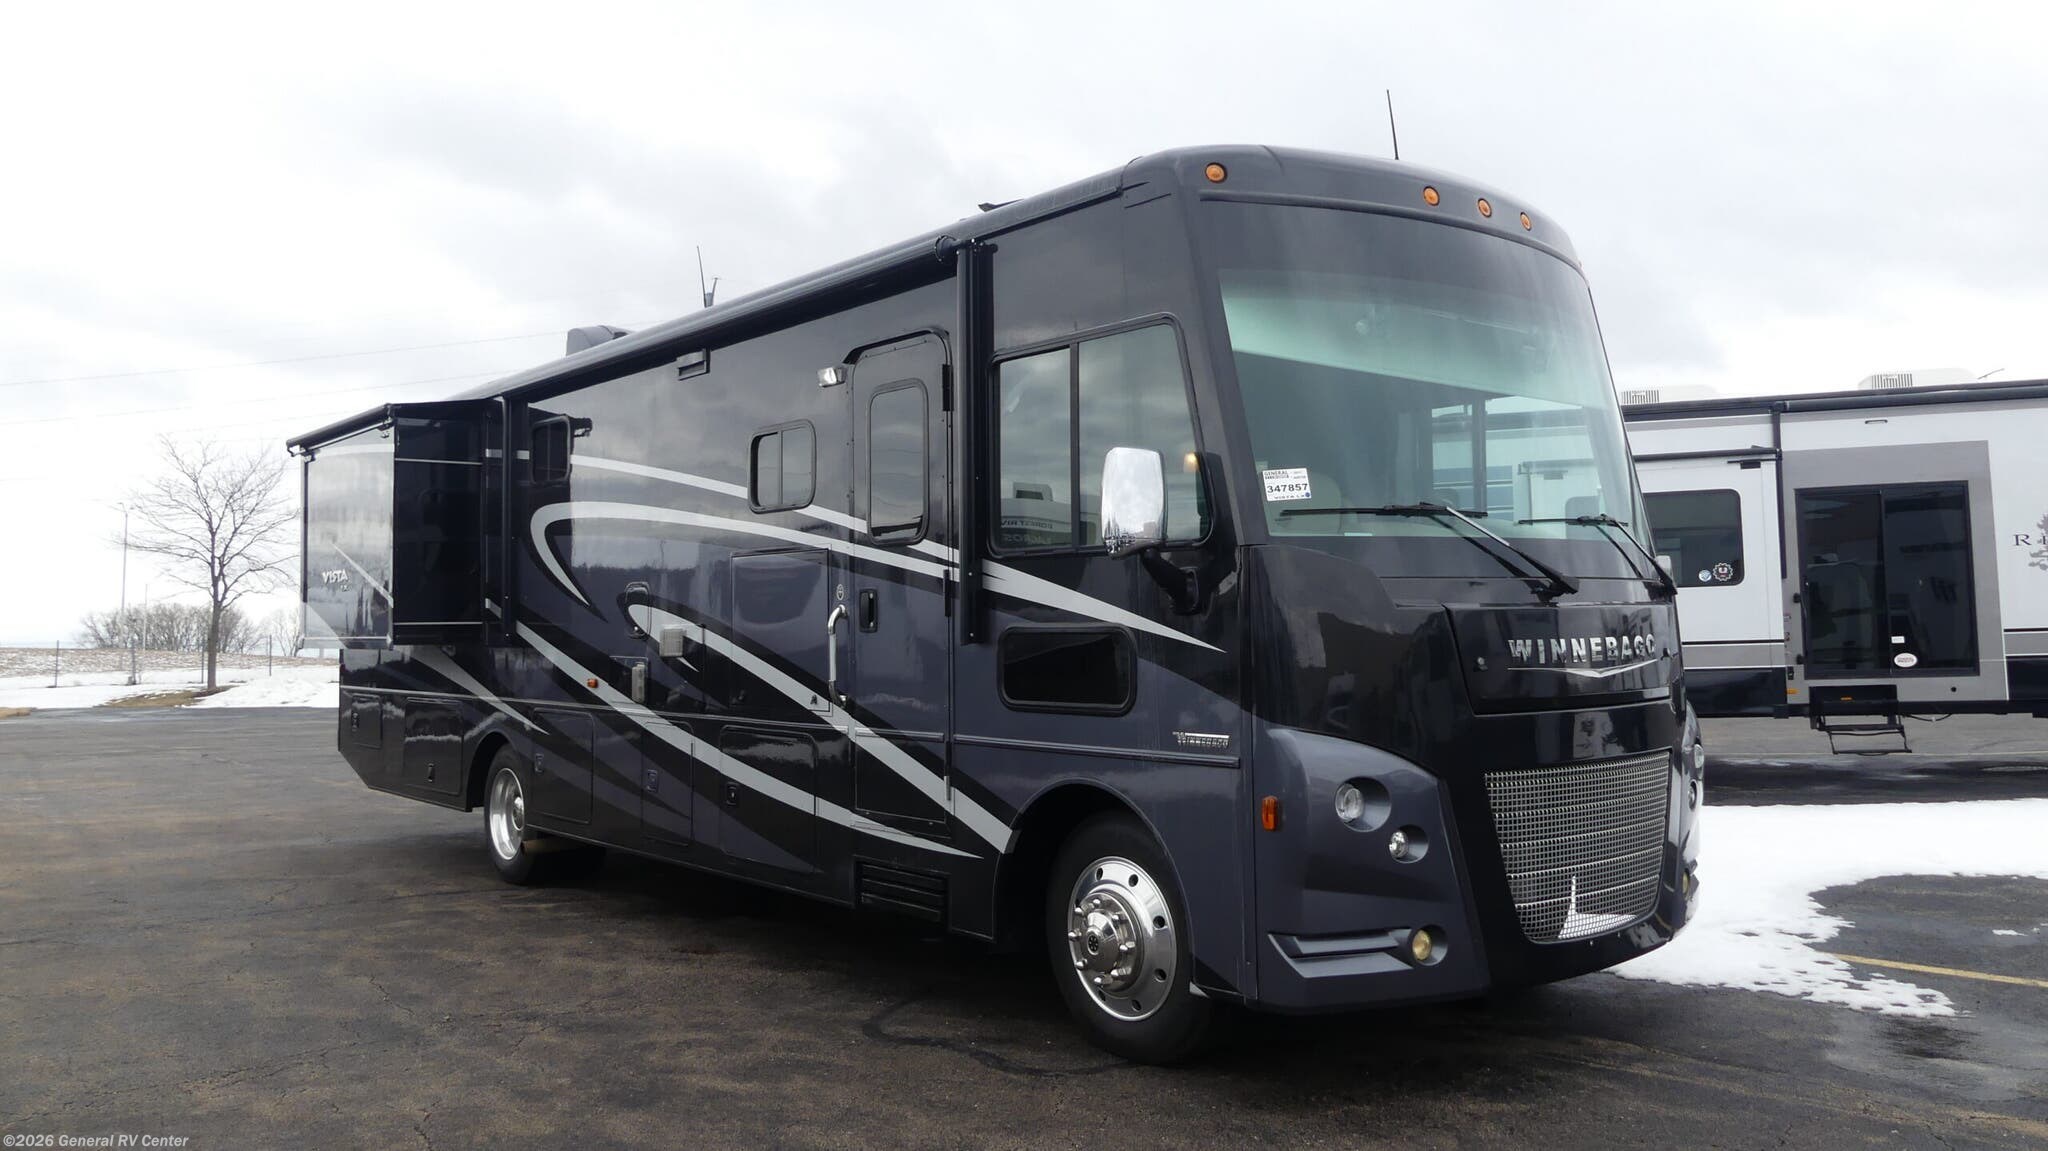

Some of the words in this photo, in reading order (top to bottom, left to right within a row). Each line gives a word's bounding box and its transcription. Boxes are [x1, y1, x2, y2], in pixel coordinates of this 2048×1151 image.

[1267, 483, 1308, 493] 347857
[322, 569, 348, 583] VISTA
[1508, 634, 1657, 664] WINNEBAGO
